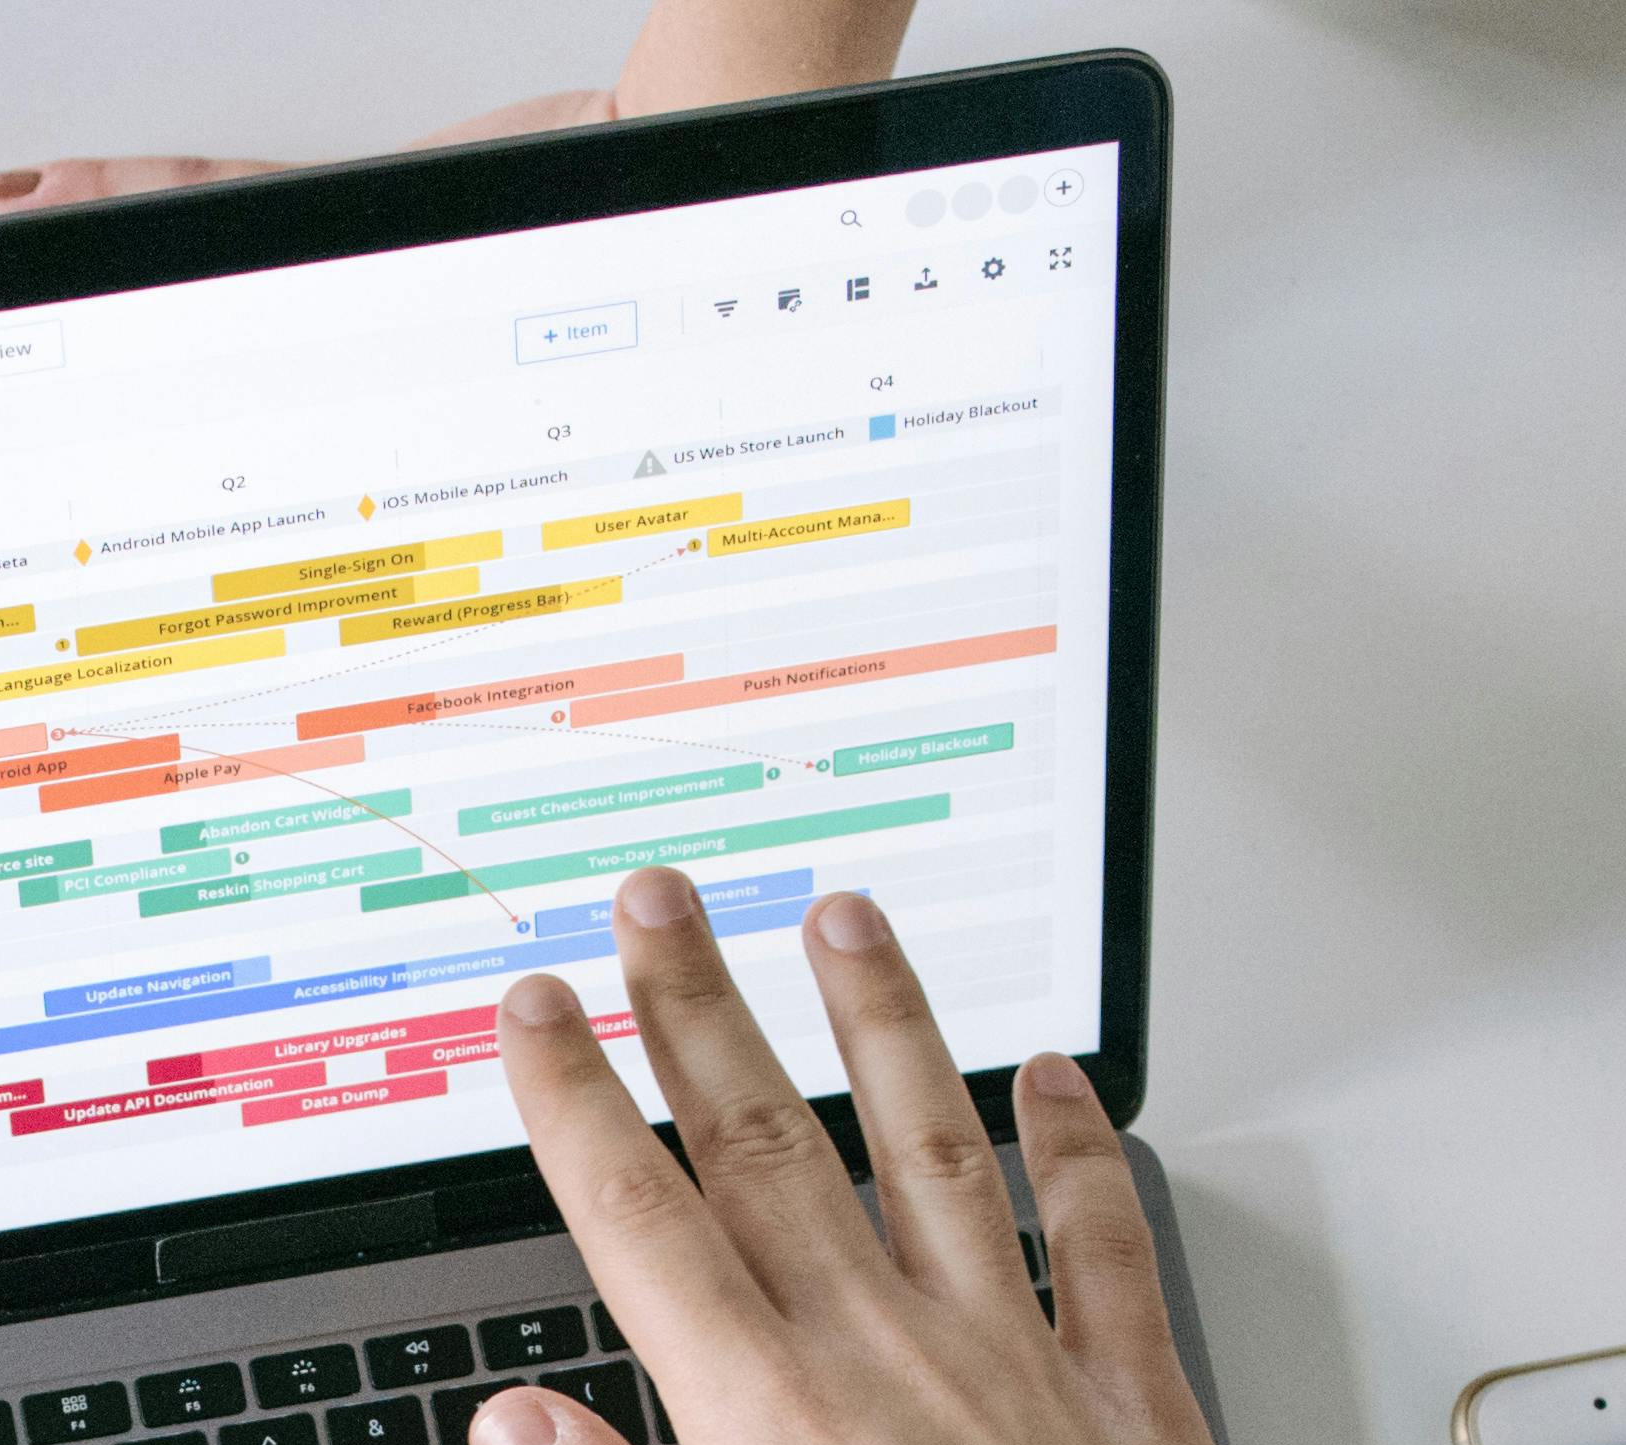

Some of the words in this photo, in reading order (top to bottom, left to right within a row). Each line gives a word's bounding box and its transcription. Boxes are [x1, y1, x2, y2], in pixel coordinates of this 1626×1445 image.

[567, 320, 608, 340] Item
[869, 375, 895, 392] Q4
[904, 409, 964, 430] Holiday
[968, 397, 1039, 419] Blackout
[547, 424, 572, 441] Q3
[674, 450, 695, 464] US
[700, 443, 735, 459] Web
[740, 437, 782, 454] Store
[787, 427, 845, 447] Launch
[222, 475, 247, 492] Q2
[382, 494, 409, 510] iOS
[415, 483, 469, 505] Mobile
[473, 479, 506, 497] App
[509, 469, 569, 489] Launch
[100, 533, 166, 554] Android
[169, 524, 226, 543] Mobile
[230, 518, 263, 536] App
[266, 507, 326, 528] Launch
[595, 518, 632, 534] User
[636, 508, 690, 528] Avatar
[722, 518, 833, 547] Multi-Account
[837, 510, 896, 530] Mana...
[299, 555, 384, 582] Single-Sign
[387, 552, 414, 569] On
[158, 616, 211, 636] Forgot
[214, 604, 293, 628] Password
[297, 586, 398, 615] Improvment
[392, 610, 453, 630] Reward
[457, 596, 532, 625] (Progress
[77, 653, 173, 681] Localization
[744, 675, 782, 692] Push
[786, 658, 886, 685] Notifications
[406, 691, 482, 715] Facebook
[487, 677, 575, 702] Integration
[858, 743, 918, 768] Holiday
[921, 733, 990, 754] Blackout
[36, 758, 68, 778] App
[163, 765, 208, 785] Apple
[213, 761, 241, 781] Pay
[490, 807, 537, 824] Guest
[541, 790, 615, 817] Checkout
[618, 774, 726, 806] Improvement
[199, 818, 271, 841] Abandon
[275, 810, 313, 828] Cart
[25, 853, 54, 871] site
[587, 847, 655, 869] Two-Day
[659, 834, 727, 862] Shipping
[64, 876, 92, 892] PCI
[96, 861, 187, 889] Compliance
[197, 881, 249, 901] Reskin
[253, 870, 333, 895] Shopping
[332, 863, 365, 879] Cart
[85, 983, 143, 1004] Update
[147, 968, 232, 995] Navigation
[294, 971, 388, 1001] Accessibility
[392, 954, 506, 986] Improvements
[274, 1035, 330, 1059] Library
[333, 1024, 408, 1052] Upgrades
[63, 1102, 121, 1121] Update
[125, 1096, 148, 1112] API
[151, 1076, 274, 1108] Documentation
[301, 1093, 334, 1111] Data
[337, 1085, 389, 1105] Dump
